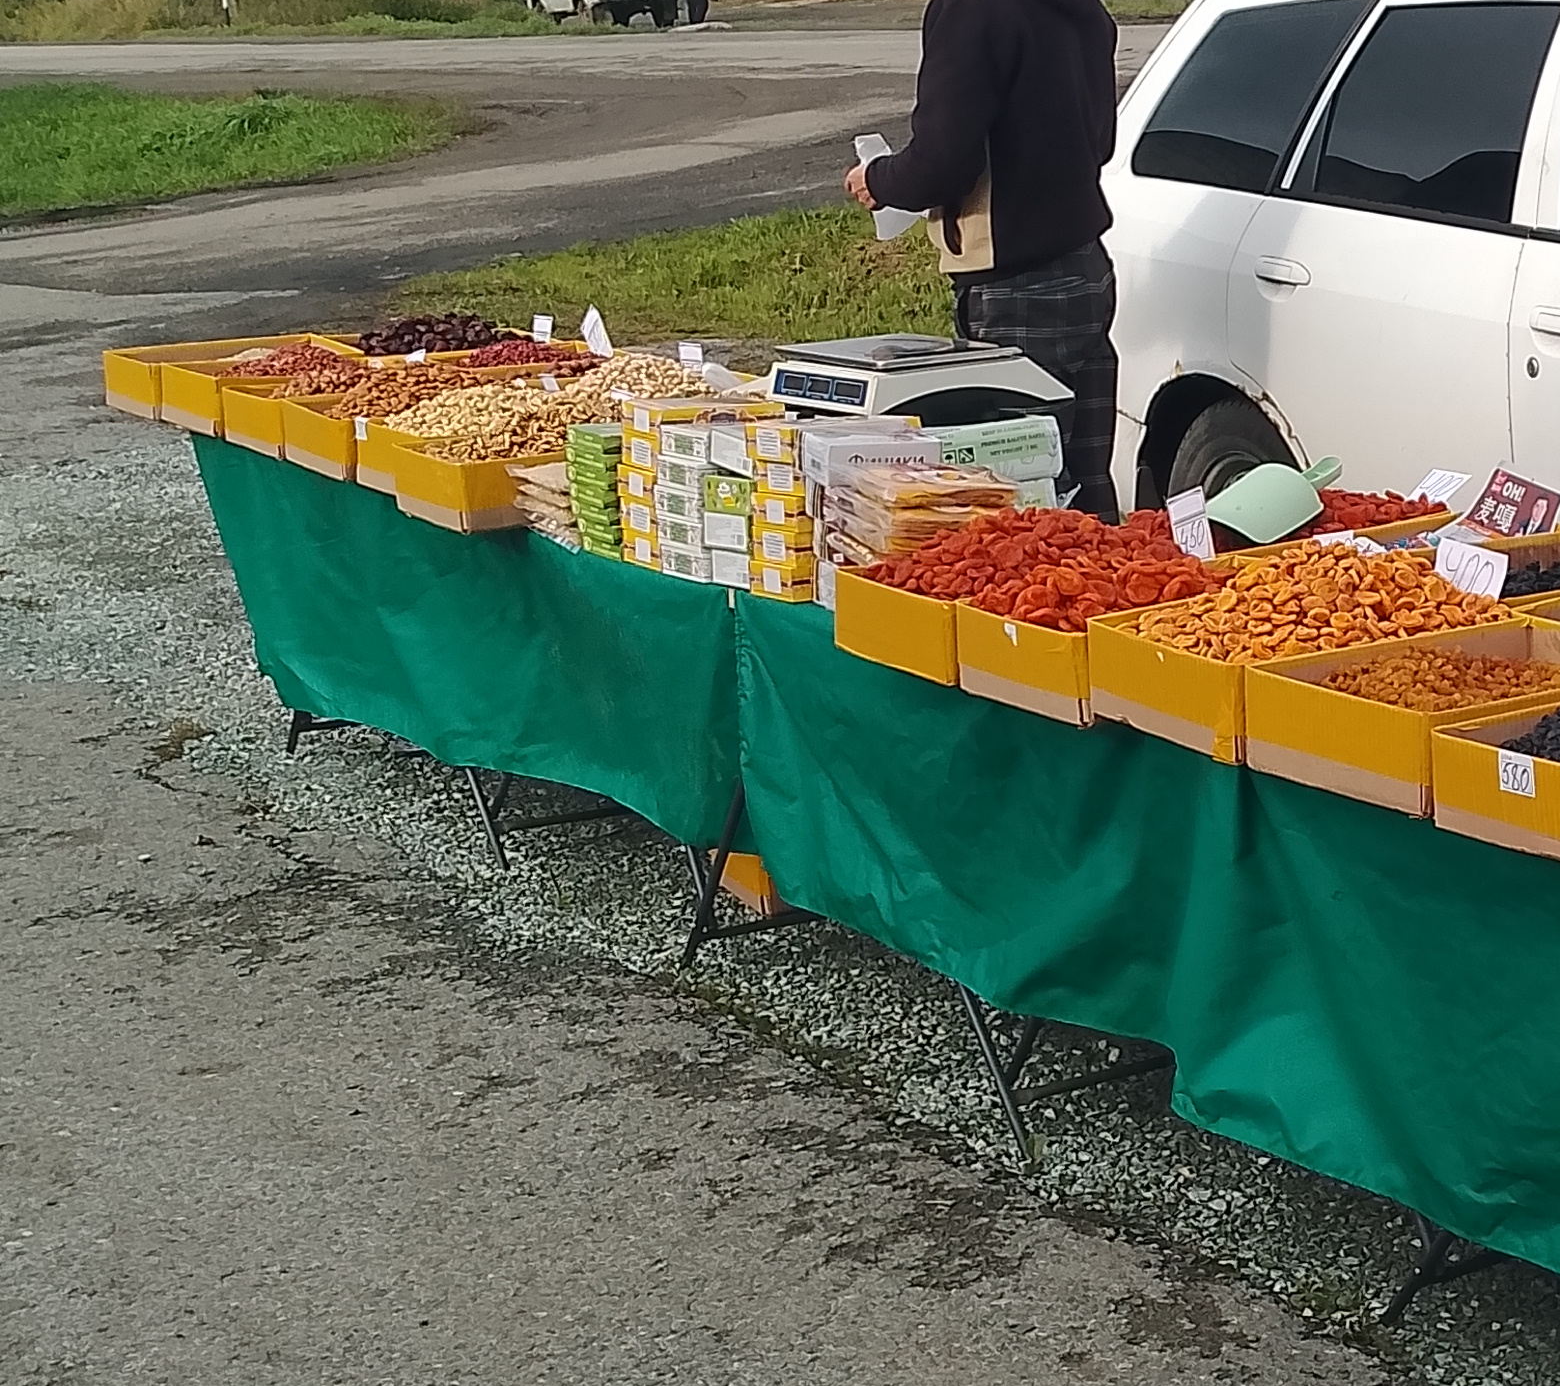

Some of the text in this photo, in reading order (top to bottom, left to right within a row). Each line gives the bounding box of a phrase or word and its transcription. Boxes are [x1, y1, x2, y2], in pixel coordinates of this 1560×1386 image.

[1502, 481, 1527, 503] OH!
[1445, 546, 1495, 596] 400
[1502, 762, 1530, 792] 580
